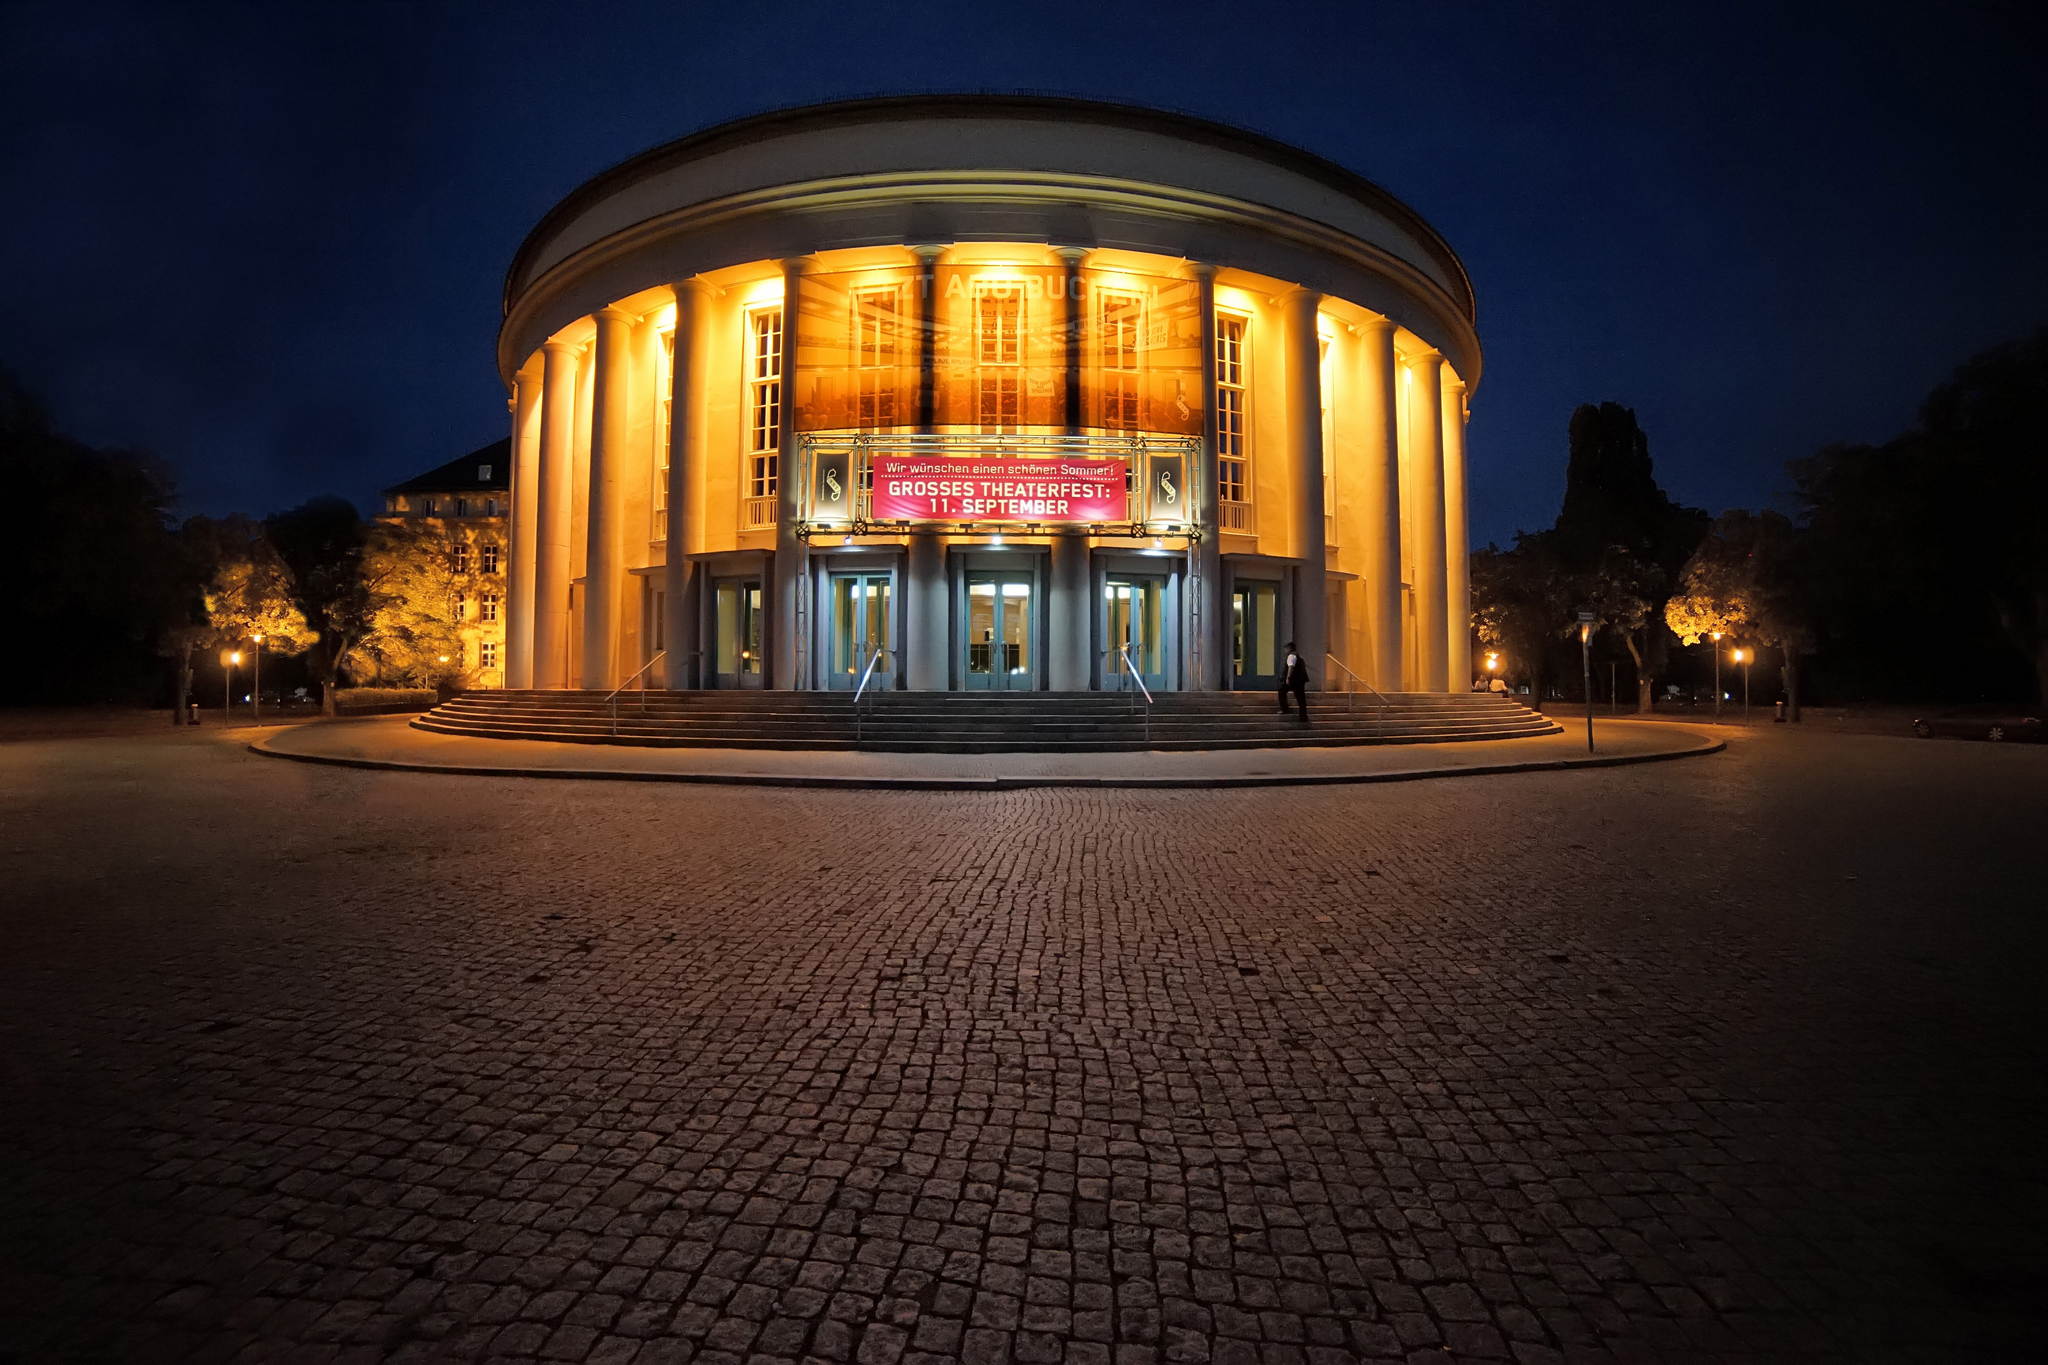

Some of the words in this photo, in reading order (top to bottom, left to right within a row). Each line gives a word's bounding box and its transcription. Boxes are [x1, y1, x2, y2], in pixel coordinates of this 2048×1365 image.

[886, 462, 906, 473] Wir
[910, 462, 969, 474] wünschen
[973, 463, 1005, 474] einen
[1008, 463, 1057, 475] schönen
[1061, 464, 1114, 476] Sommer!
[888, 481, 974, 496] GROSSES
[981, 482, 1110, 498] THEATERFEST:
[930, 498, 956, 513] 11.
[963, 499, 1068, 514] SEPTEMBER
